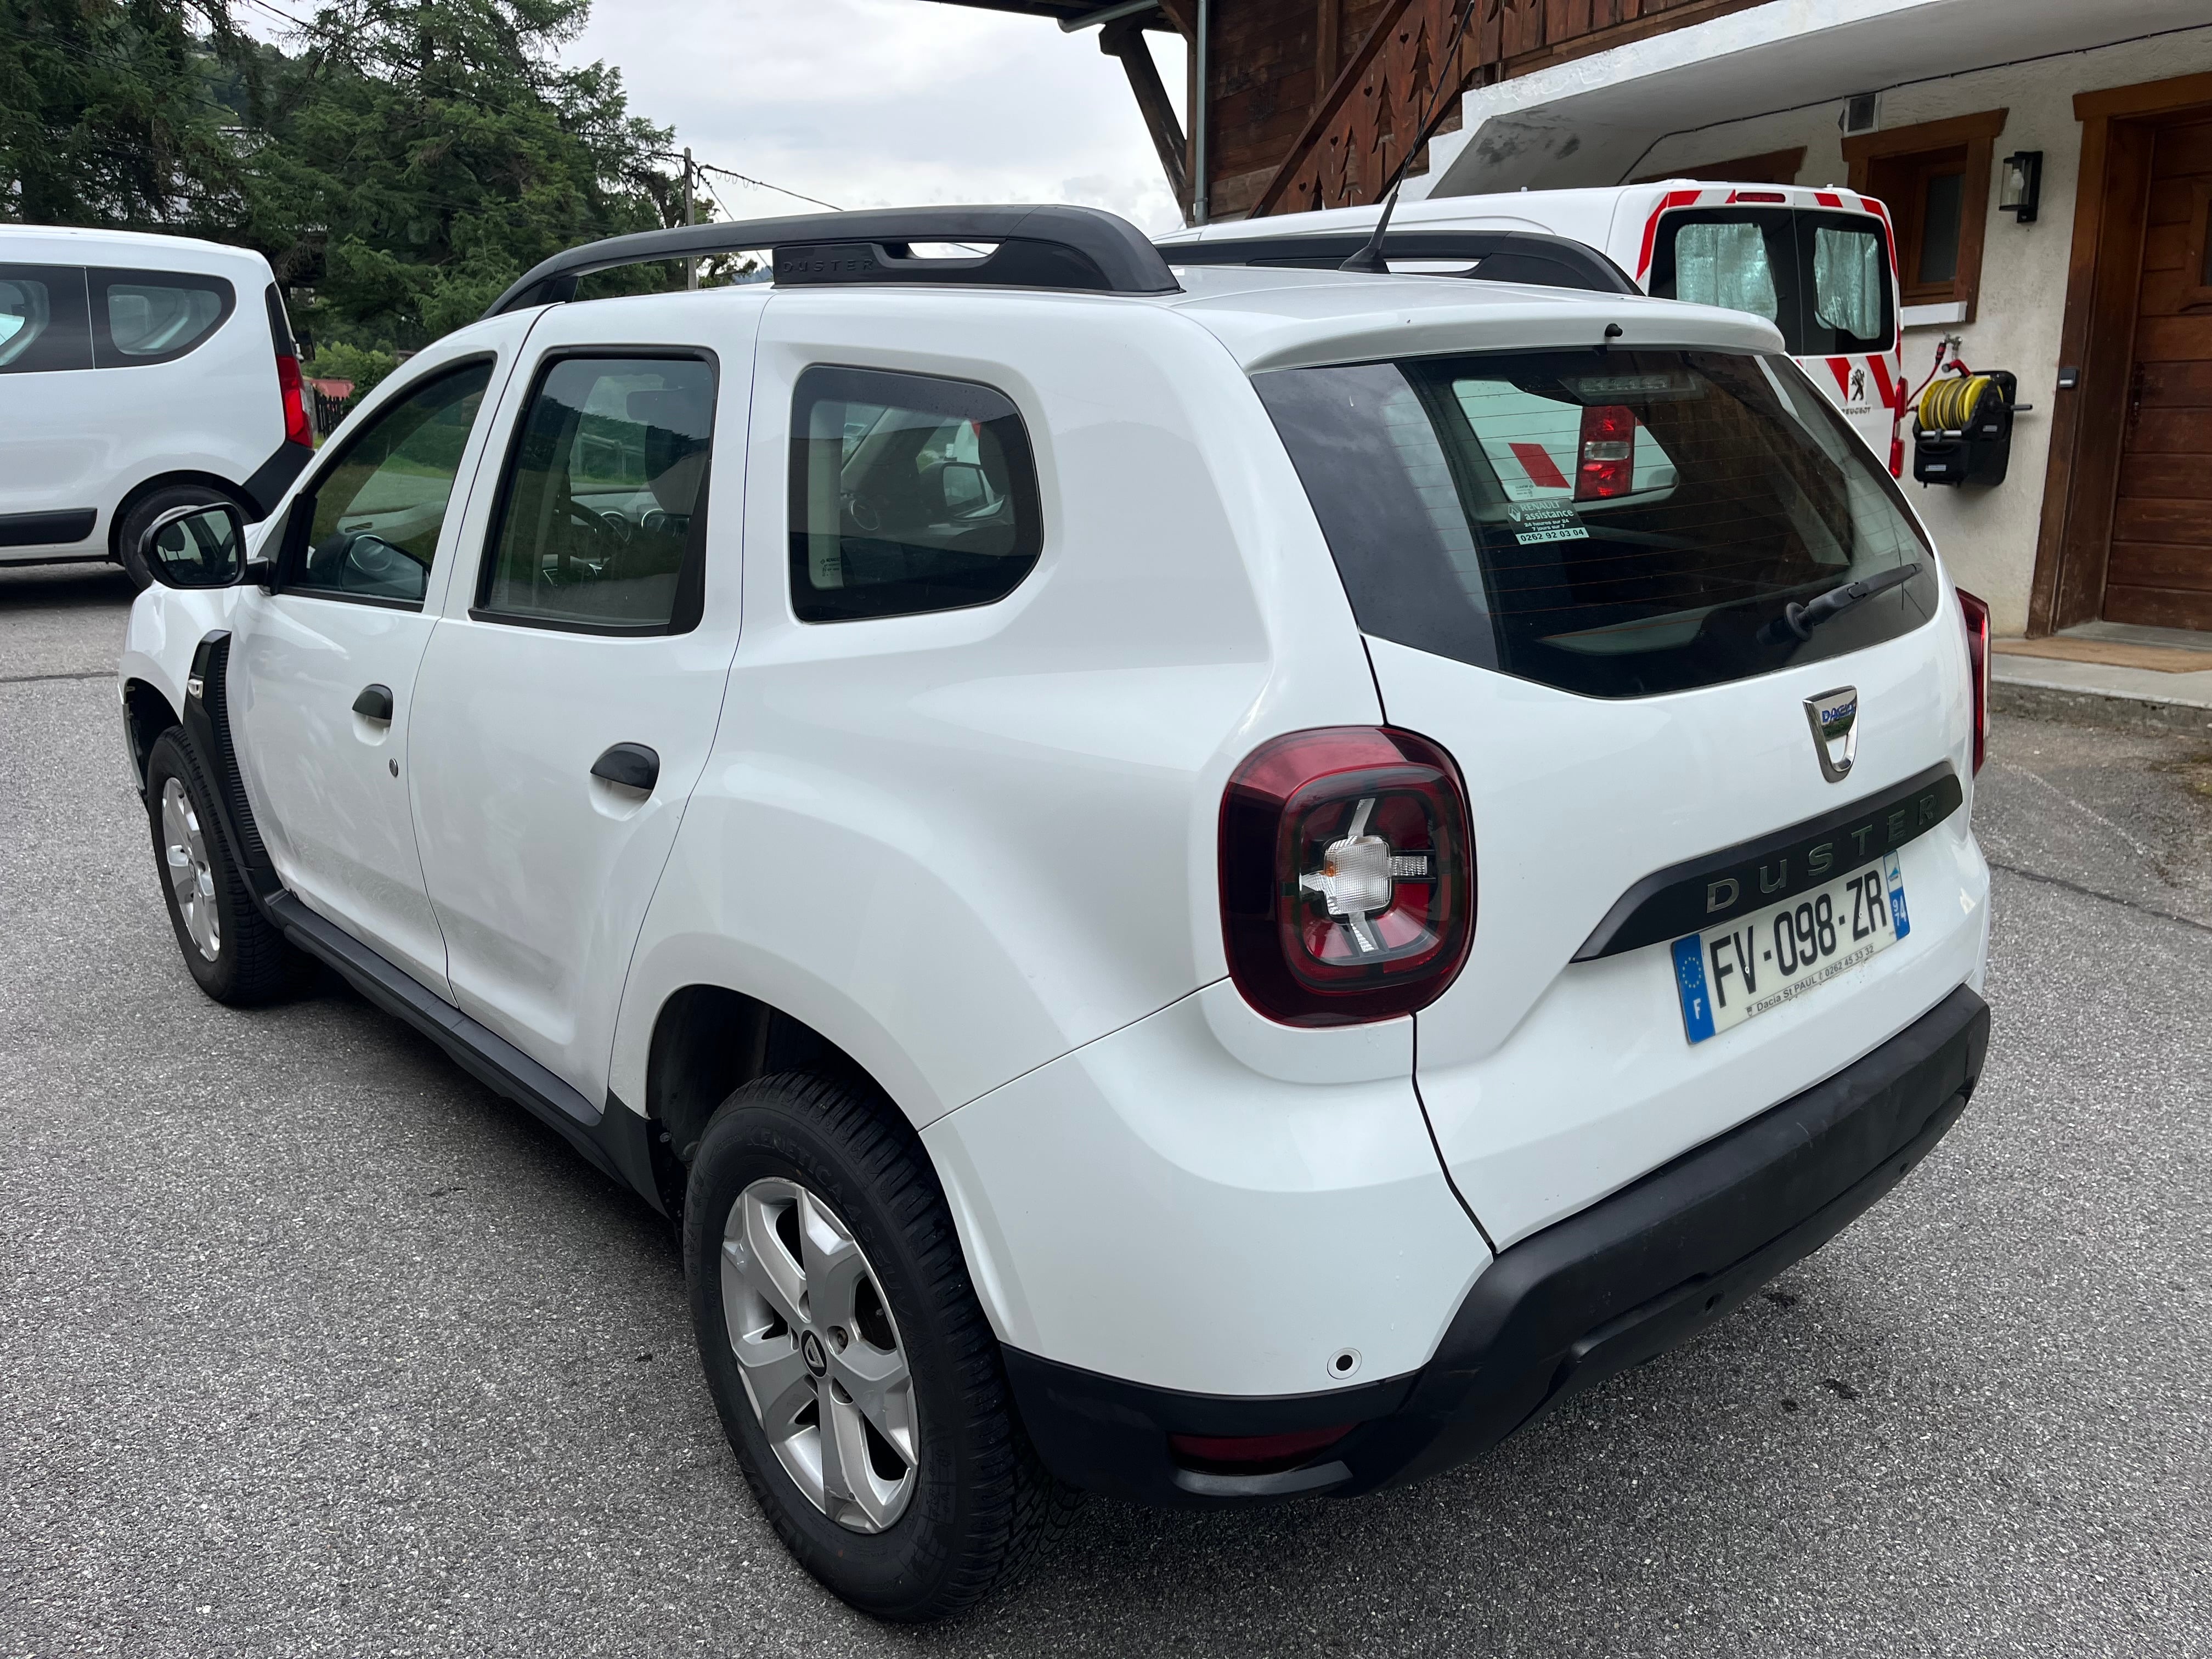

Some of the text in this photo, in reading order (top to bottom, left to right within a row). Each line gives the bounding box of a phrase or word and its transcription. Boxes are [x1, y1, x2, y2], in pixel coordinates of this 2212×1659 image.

[783, 259, 874, 272] DUSTER
[1520, 500, 1560, 511] RENAULT
[1524, 509, 1574, 521] assistance
[1521, 533, 1543, 541] 0262
[1821, 703, 1855, 723] DACIA
[1706, 794, 1936, 913] DUSTER
[1693, 870, 1888, 1020] F FV-098-ZR
[1757, 945, 1874, 1012] Dacia St PAUL 0262 45 33 32
[746, 1124, 844, 1204] KENETICA
